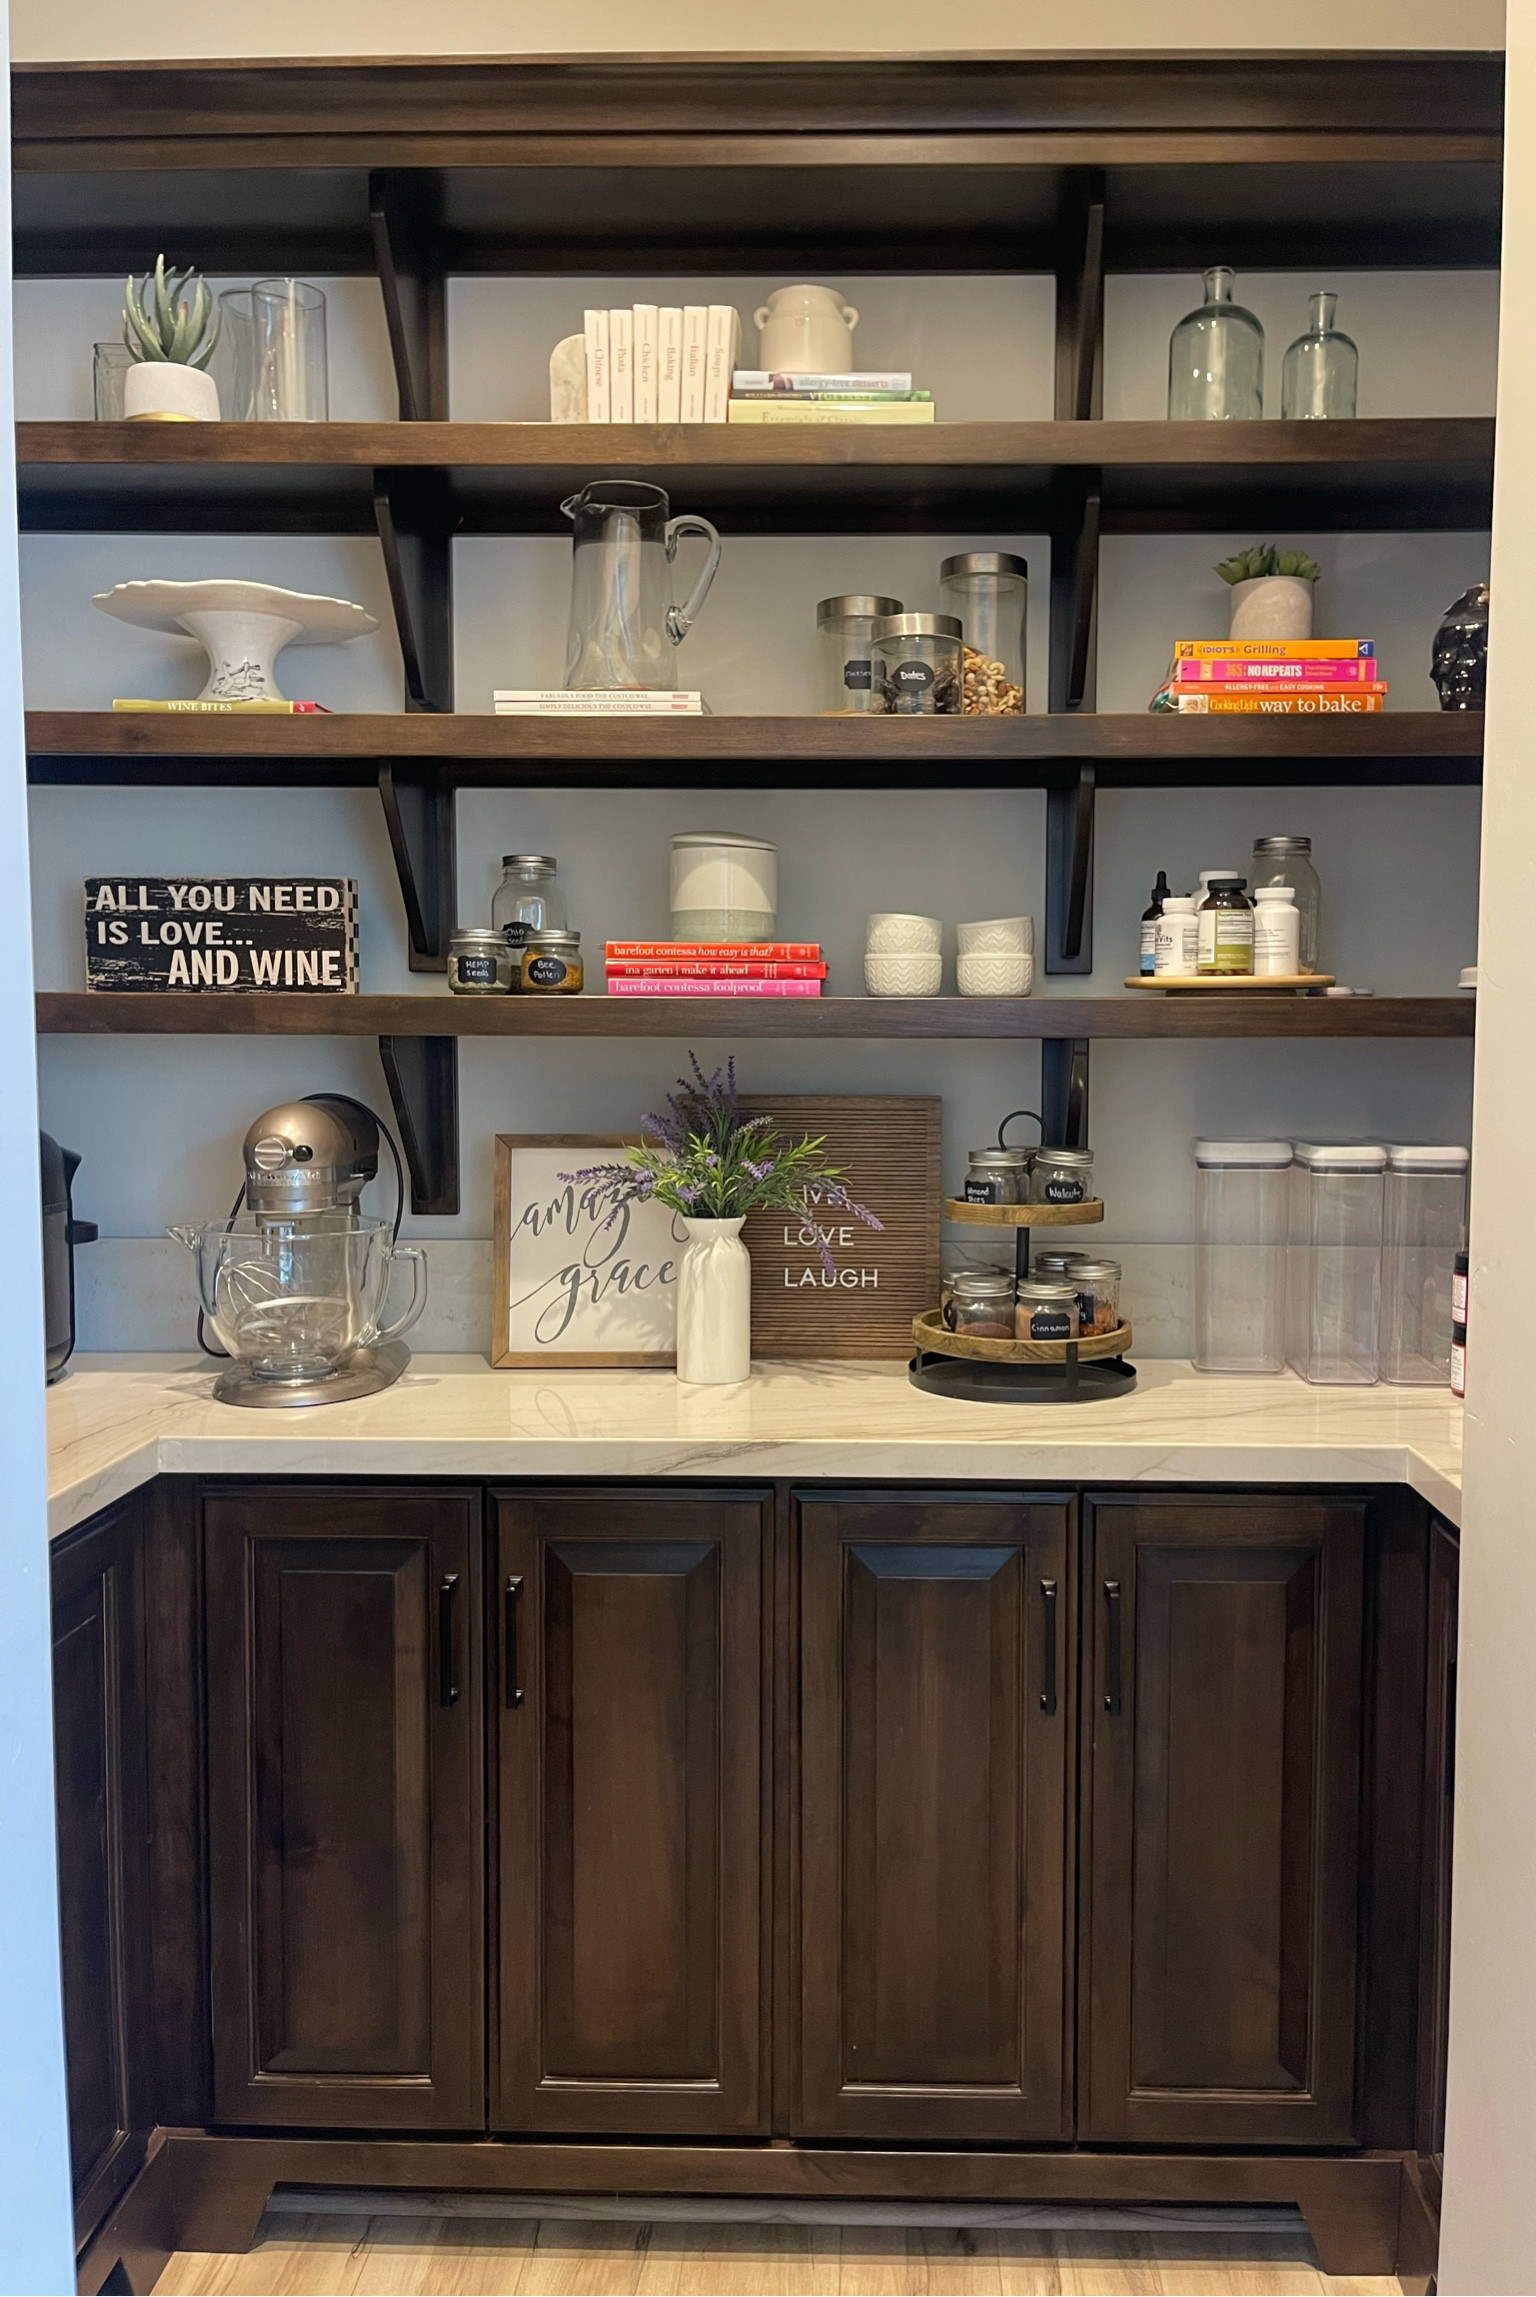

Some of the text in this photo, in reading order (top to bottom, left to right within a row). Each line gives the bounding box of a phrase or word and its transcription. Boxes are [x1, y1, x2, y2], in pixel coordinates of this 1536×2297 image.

[617, 347, 627, 373] Pasta
[641, 342, 652, 383] Chicken
[663, 346, 677, 381] Baking
[689, 345, 699, 377] Italian
[711, 347, 724, 378] Soups
[1203, 645, 1286, 656] IDIOT'S Grilling
[900, 670, 926, 680] Dates
[1247, 665, 1261, 677] NO
[1261, 665, 1302, 677] REPEATS
[167, 702, 232, 711] WINE BITES
[1210, 699, 1239, 713] Cooking
[1259, 701, 1293, 713] way
[1297, 698, 1316, 713] to
[1319, 694, 1362, 713] bake
[95, 885, 340, 912] ALL YOU NEED
[98, 921, 253, 945] IS LOVE...
[614, 945, 654, 956] barefoot
[656, 947, 697, 956] contessa
[698, 946, 718, 956] how
[719, 949, 739, 960] easy
[740, 948, 749, 957] is
[749, 946, 774, 957] that?
[168, 950, 342, 986] AND WINE
[465, 960, 490, 969] HEMP
[538, 960, 557, 969] Bee
[625, 964, 640, 975] ina
[643, 967, 673, 978] garten
[681, 963, 707, 975] make
[710, 965, 717, 975] it
[720, 963, 749, 975] ahead
[615, 981, 661, 993] barefoot
[664, 983, 710, 993] contessa
[713, 981, 765, 996] foolproof
[784, 1226, 855, 1246] LOVE
[784, 1267, 879, 1288] LAUGH
[510, 1259, 678, 1344] grace
[1031, 1323, 1070, 1333] Cinnamon
